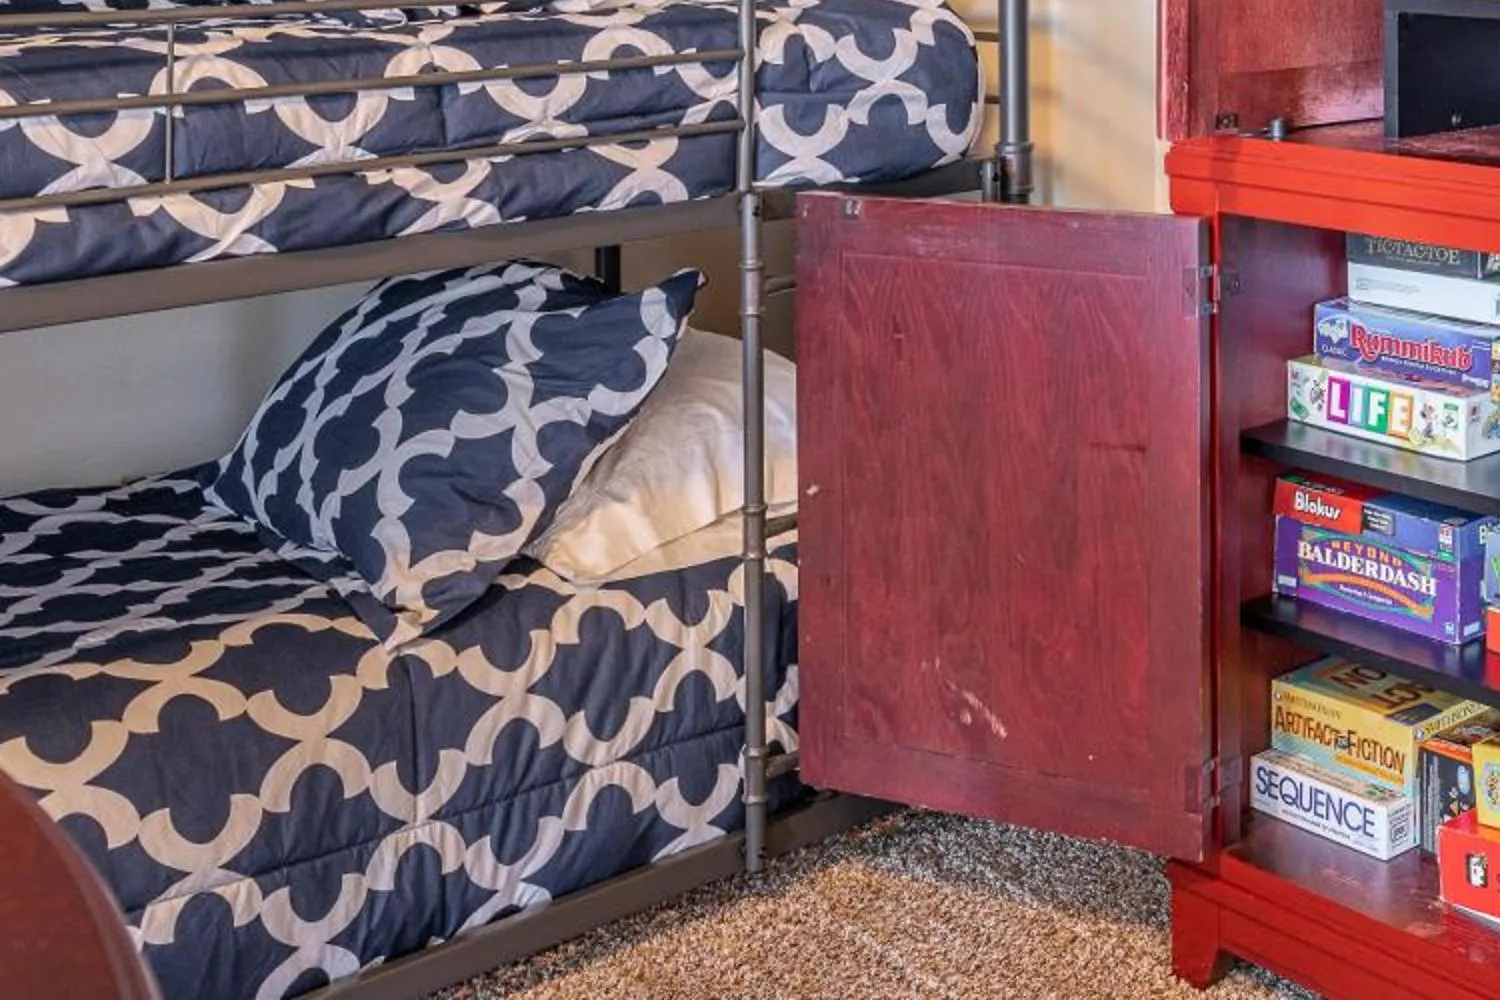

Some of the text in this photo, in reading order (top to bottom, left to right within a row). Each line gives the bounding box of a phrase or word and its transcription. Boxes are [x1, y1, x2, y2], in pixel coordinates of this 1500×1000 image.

[1351, 323, 1473, 371] Rummikub
[1329, 380, 1411, 432] LIFE
[1294, 491, 1341, 520] Blokus
[1297, 541, 1437, 597] BALDERDASH
[1331, 540, 1403, 567] BEYOND
[1275, 705, 1341, 747] ARTIFACT
[1347, 729, 1405, 774] FICTION
[1255, 766, 1375, 838] SEQUENCE
